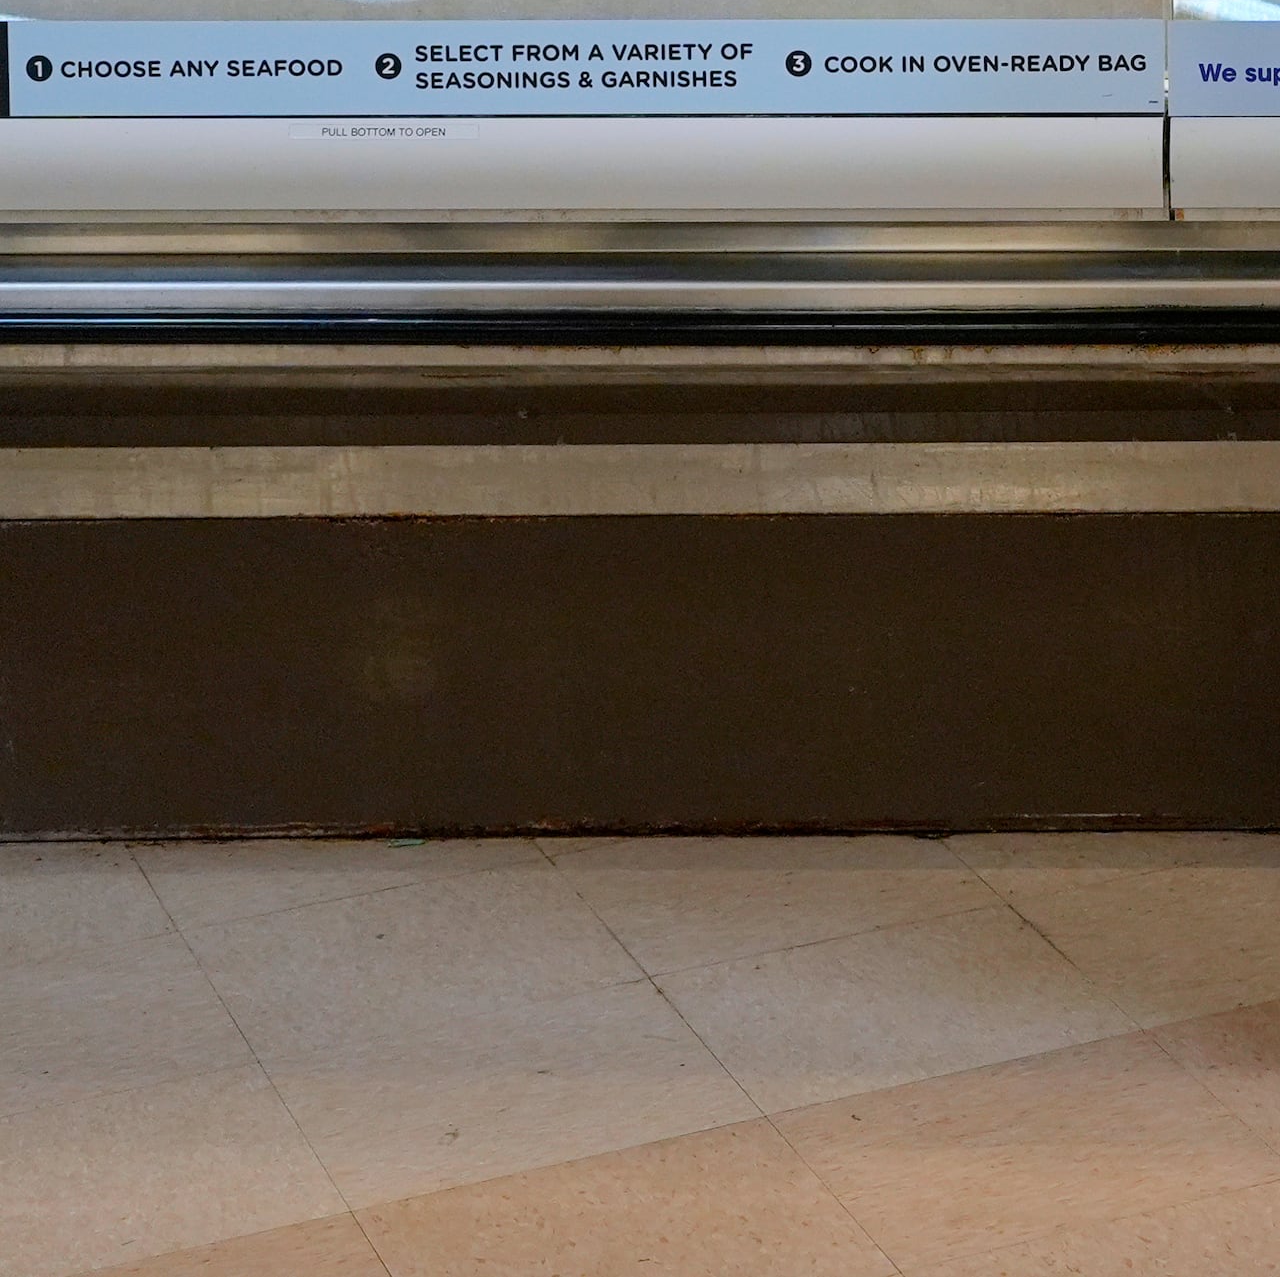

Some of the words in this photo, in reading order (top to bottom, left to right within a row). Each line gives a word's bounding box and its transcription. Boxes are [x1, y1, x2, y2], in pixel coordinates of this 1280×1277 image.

[415, 44, 504, 62] SELECT
[512, 44, 579, 62] FROM
[588, 44, 605, 62] A
[611, 44, 715, 62] VARIETY
[721, 44, 753, 62] OF
[61, 60, 162, 78] CHOOSE
[169, 60, 219, 77] ANY
[227, 59, 343, 77] SEAFOOD
[824, 55, 893, 73] COOK
[901, 55, 926, 72] IN
[934, 55, 1090, 73] OVEN-READY
[1098, 54, 1147, 72] BAG
[1199, 63, 1237, 82] We
[415, 72, 571, 89] SEASONINGS
[578, 71, 594, 89] &
[601, 70, 737, 88] GARNISHES
[321, 127, 347, 137] PULL
[351, 127, 396, 137] BOTTOM
[399, 127, 413, 137] TO
[416, 127, 446, 137] OPEN
